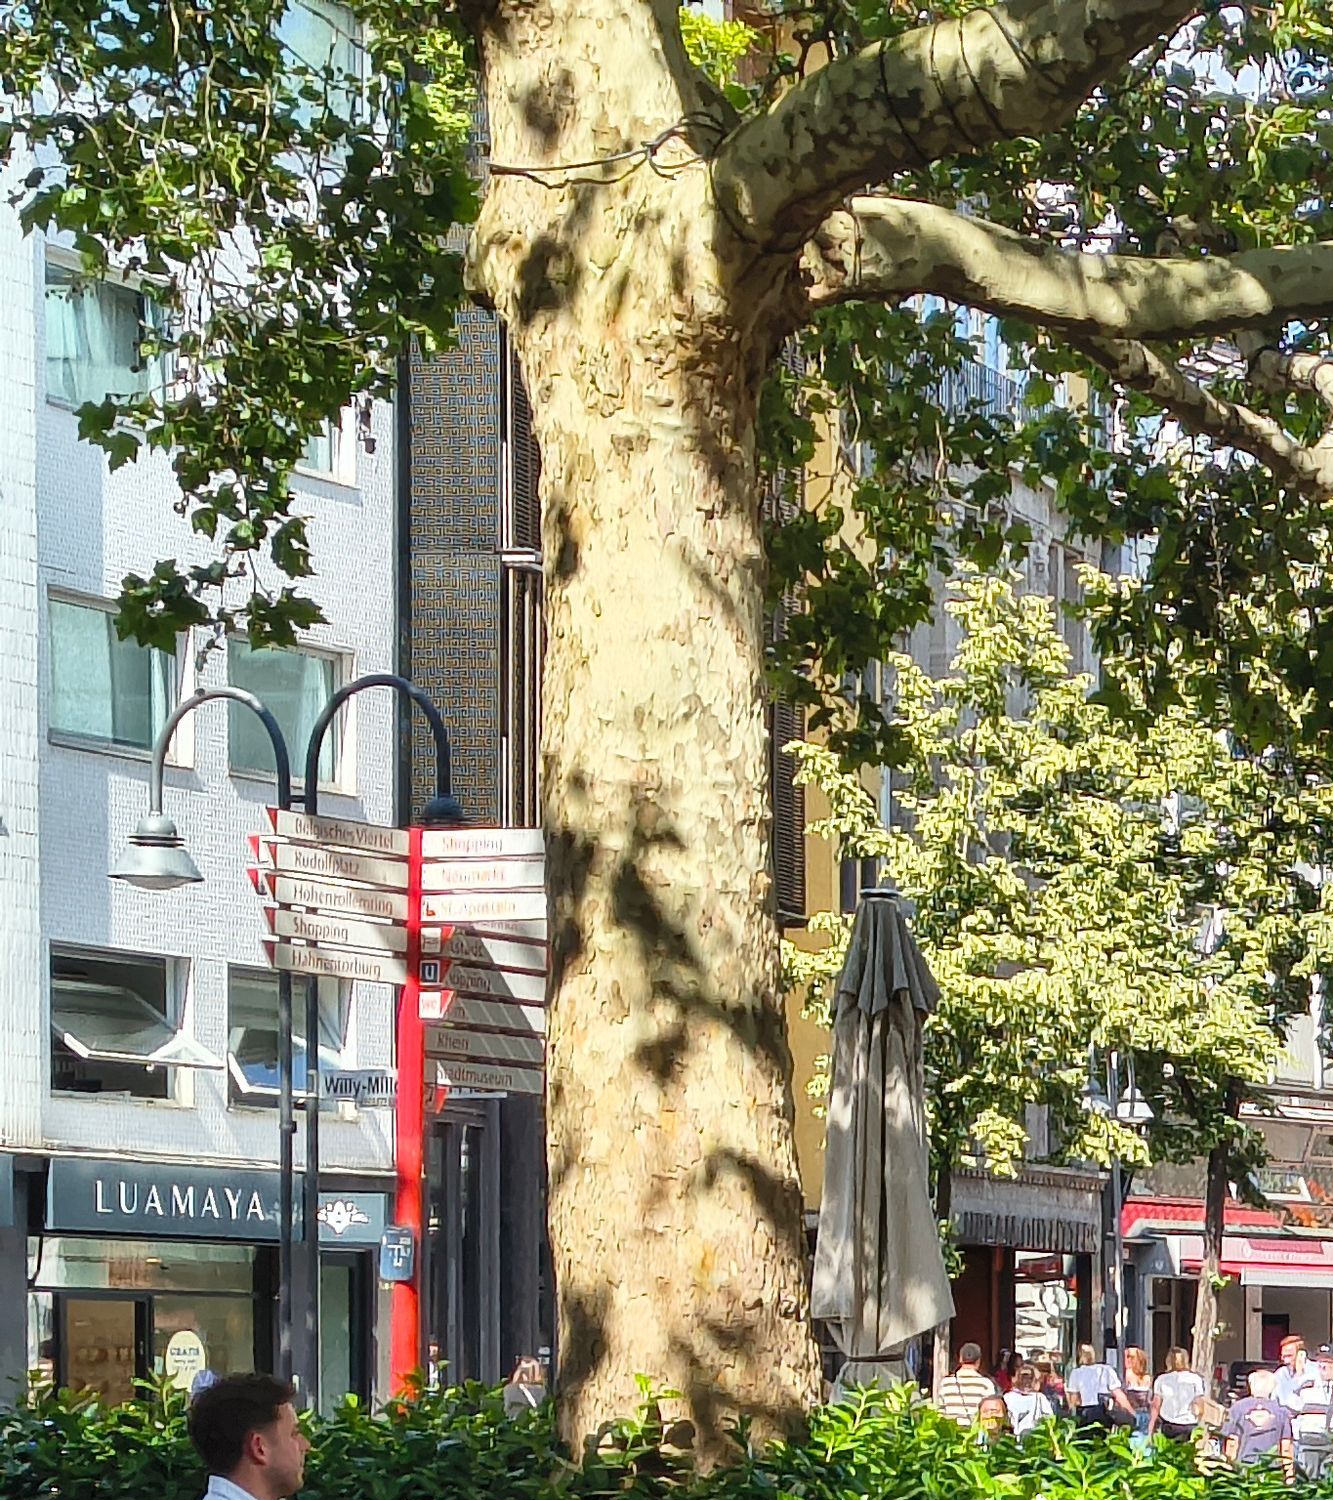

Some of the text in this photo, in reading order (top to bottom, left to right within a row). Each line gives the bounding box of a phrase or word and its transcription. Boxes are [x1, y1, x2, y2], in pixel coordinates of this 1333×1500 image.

[295, 817, 394, 850] Belgisches Viertel
[294, 850, 360, 876] Rudolfplatz
[294, 916, 349, 942] Shopping
[291, 948, 382, 980] Hahnentorburg
[424, 964, 437, 981] U
[437, 1031, 470, 1051] Rhein
[96, 1179, 266, 1222] LUAMAYA
